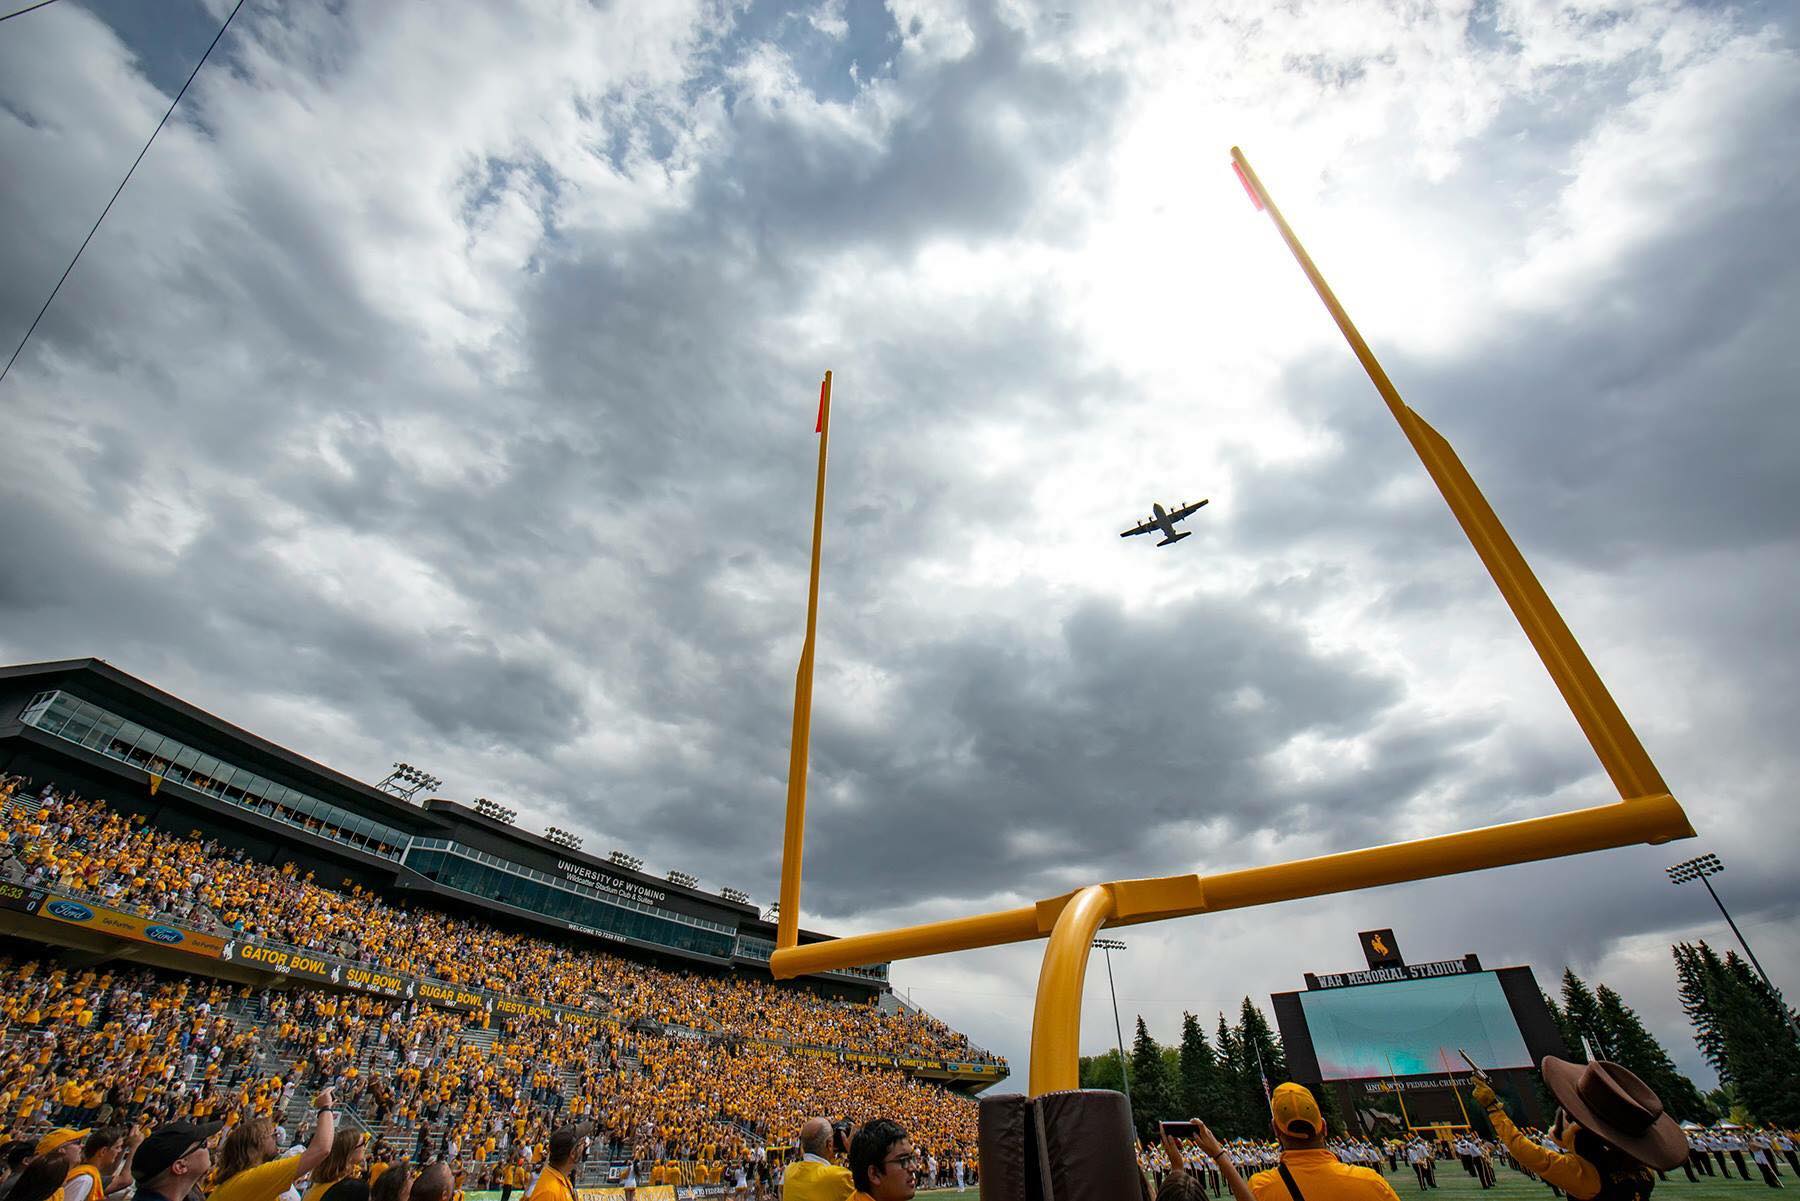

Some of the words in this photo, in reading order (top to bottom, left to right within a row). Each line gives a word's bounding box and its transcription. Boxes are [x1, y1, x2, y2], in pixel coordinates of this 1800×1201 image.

[557, 860, 611, 883] UNIVERSITY
[612, 878, 625, 888] OF
[625, 882, 666, 901] WYOMING
[566, 872, 595, 888] Wildcatter
[595, 881, 618, 895] Stadium
[618, 889, 632, 900] Club
[636, 894, 654, 906] Suites
[26, 901, 36, 911] 0
[568, 923, 595, 935] WELCOME
[613, 935, 627, 943] FEET
[240, 945, 289, 966] GATOR
[290, 956, 327, 975] BOWL
[274, 964, 291, 974] 1950
[346, 968, 371, 984] SUN
[371, 974, 402, 991] BOWL
[1317, 976, 1344, 988] WAR
[1348, 967, 1408, 985] MEMORIAL
[1411, 960, 1467, 978] STADIUM
[419, 984, 454, 1000] SUGAR
[456, 991, 483, 1007] BOWL
[496, 1000, 527, 1015] FIESTA
[528, 1006, 552, 1020] BOWL
[1406, 1080, 1439, 1089] FEDERAL
[1439, 1078, 1466, 1088] CREDIT
